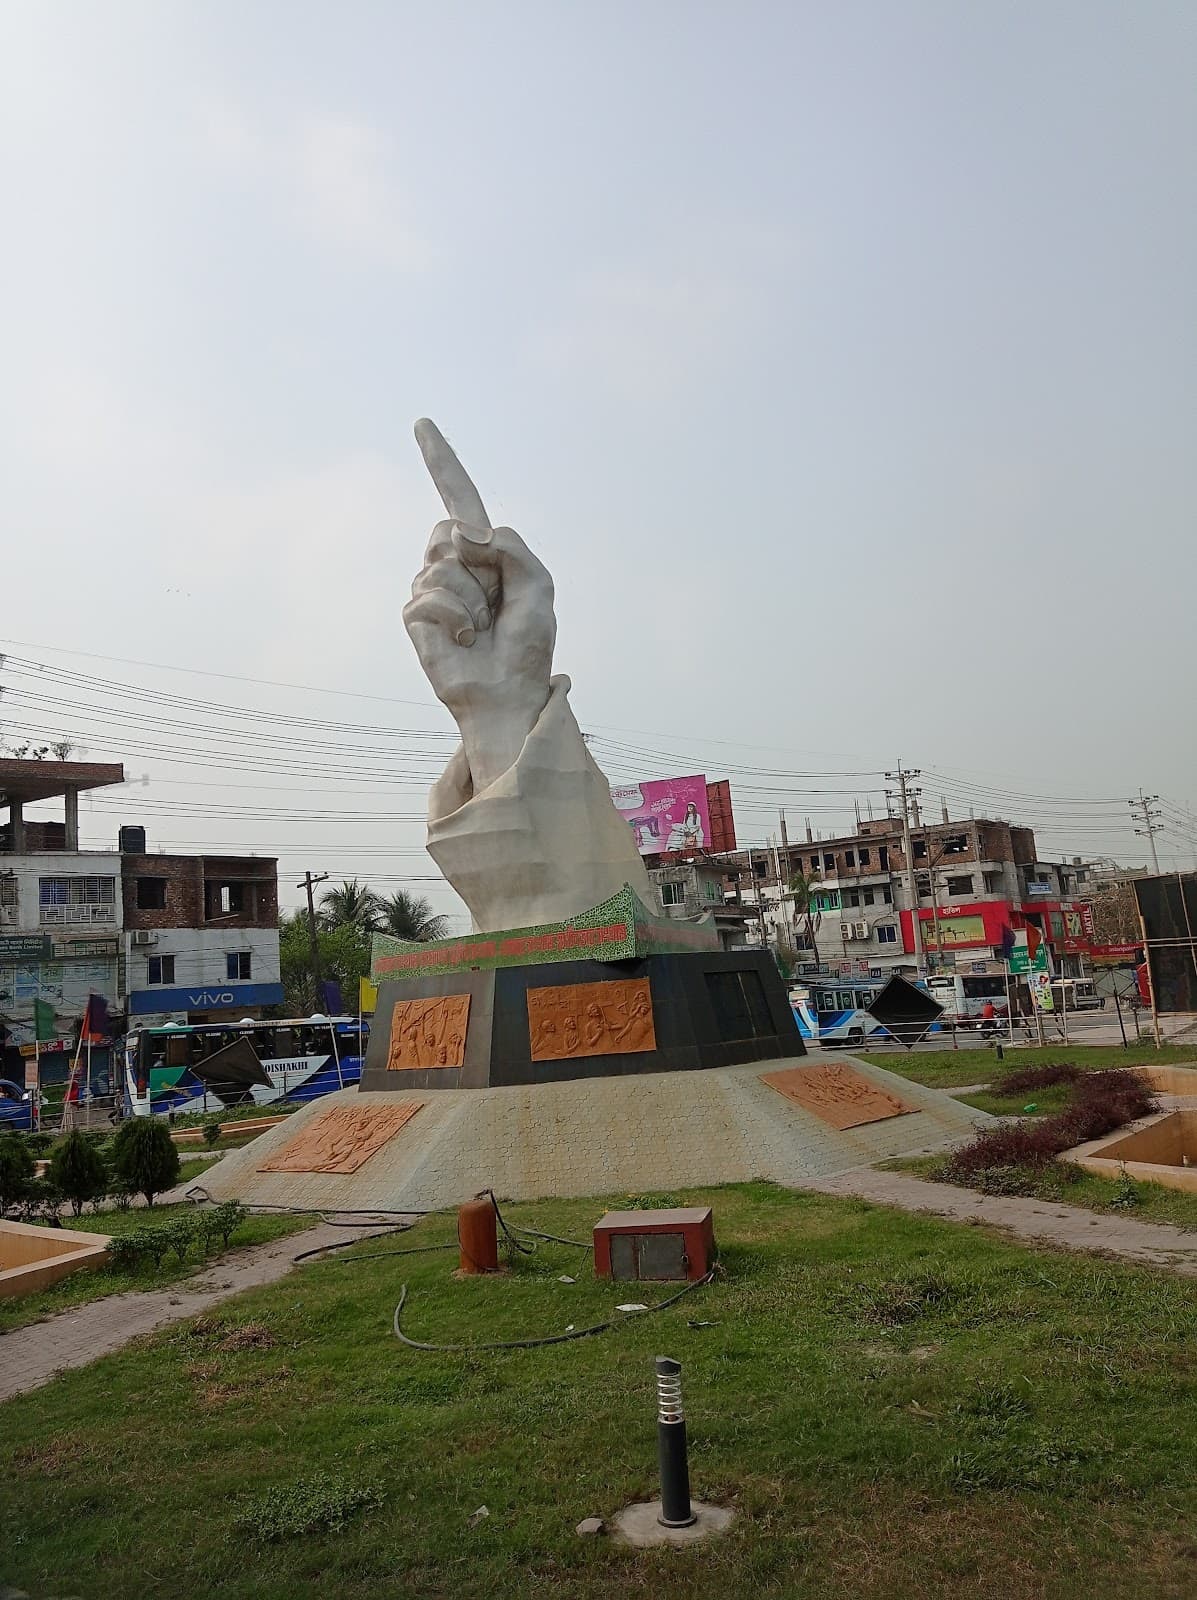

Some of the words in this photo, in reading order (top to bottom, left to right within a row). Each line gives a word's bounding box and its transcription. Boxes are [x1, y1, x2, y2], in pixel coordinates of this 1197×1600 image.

[1082, 908, 1094, 935] HATIL
[188, 991, 234, 1006] vivo
[264, 1061, 308, 1073] OISHAKHI
